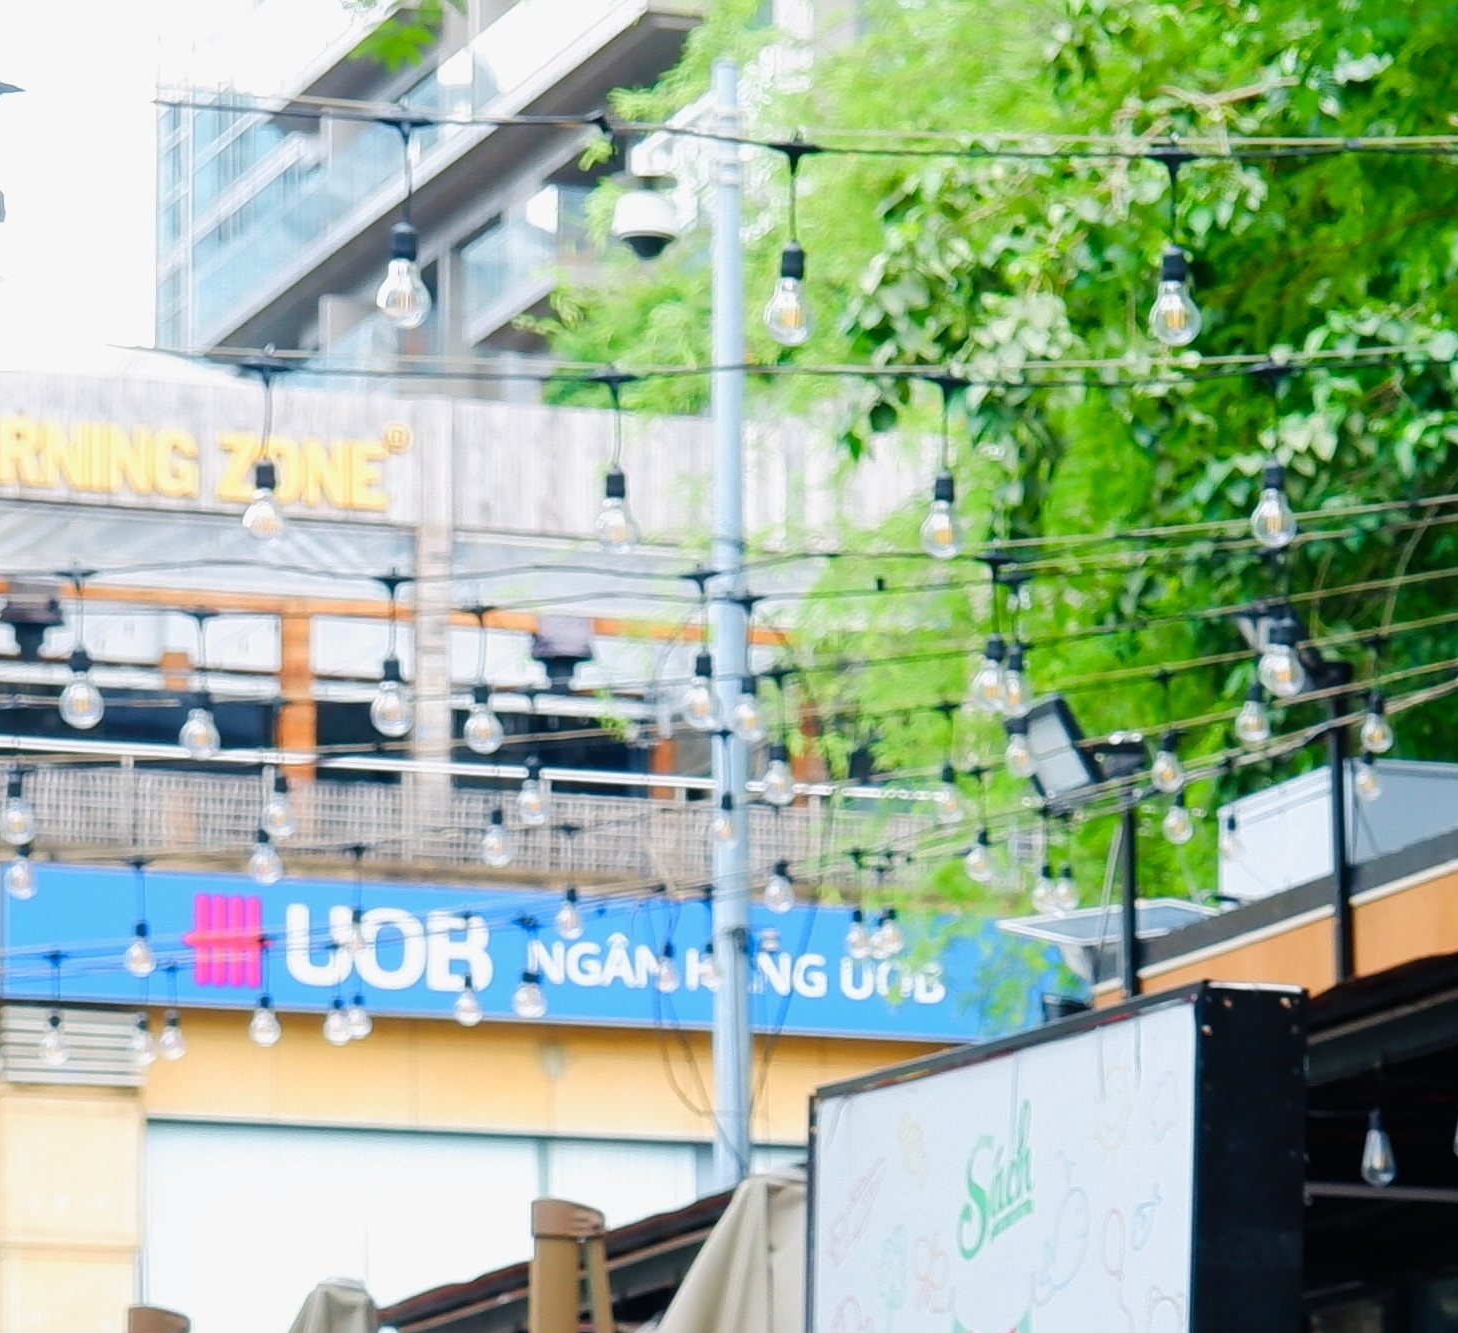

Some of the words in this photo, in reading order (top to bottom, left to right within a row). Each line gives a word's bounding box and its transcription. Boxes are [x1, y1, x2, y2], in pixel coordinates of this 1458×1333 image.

[217, 432, 390, 511] ZONE
[285, 902, 493, 993] UOB
[686, 948, 828, 999] HNG
